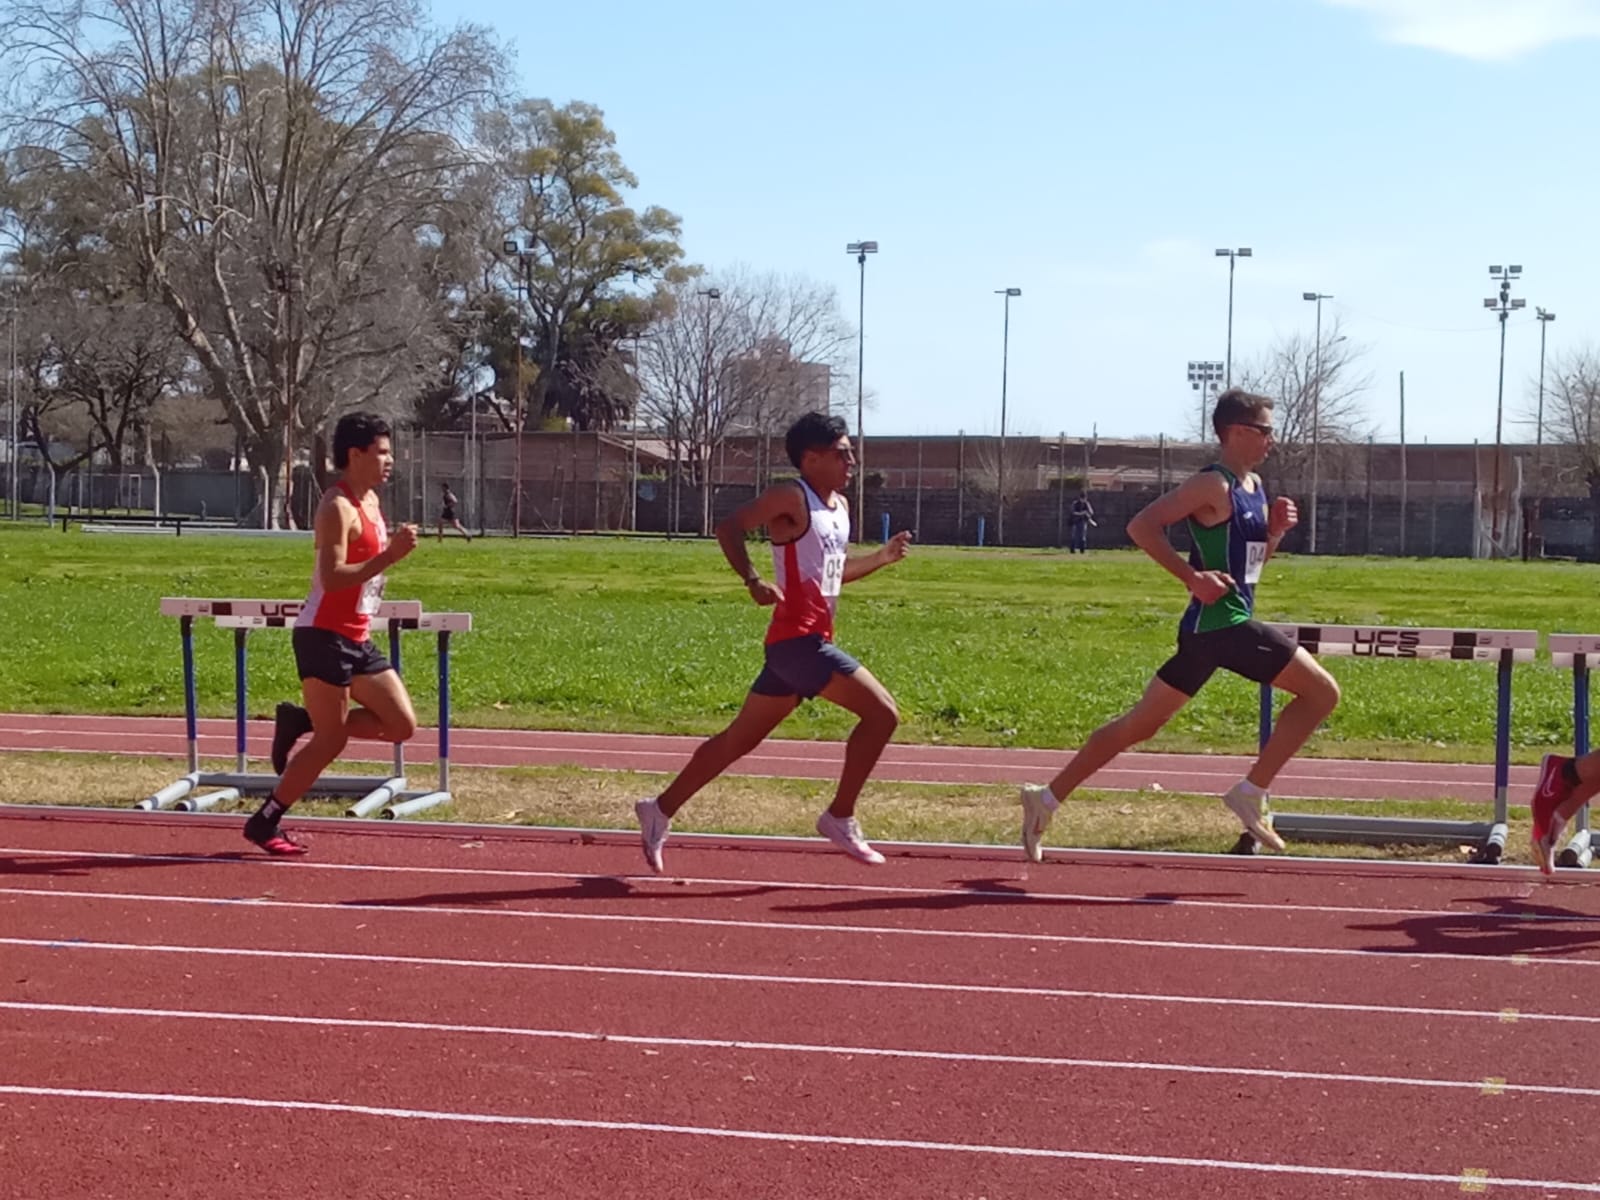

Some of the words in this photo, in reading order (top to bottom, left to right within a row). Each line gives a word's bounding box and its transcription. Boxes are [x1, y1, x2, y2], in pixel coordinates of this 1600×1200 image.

[260, 603, 305, 617] UC
[1354, 629, 1420, 645] UCS
[1352, 643, 1418, 658] UCS
